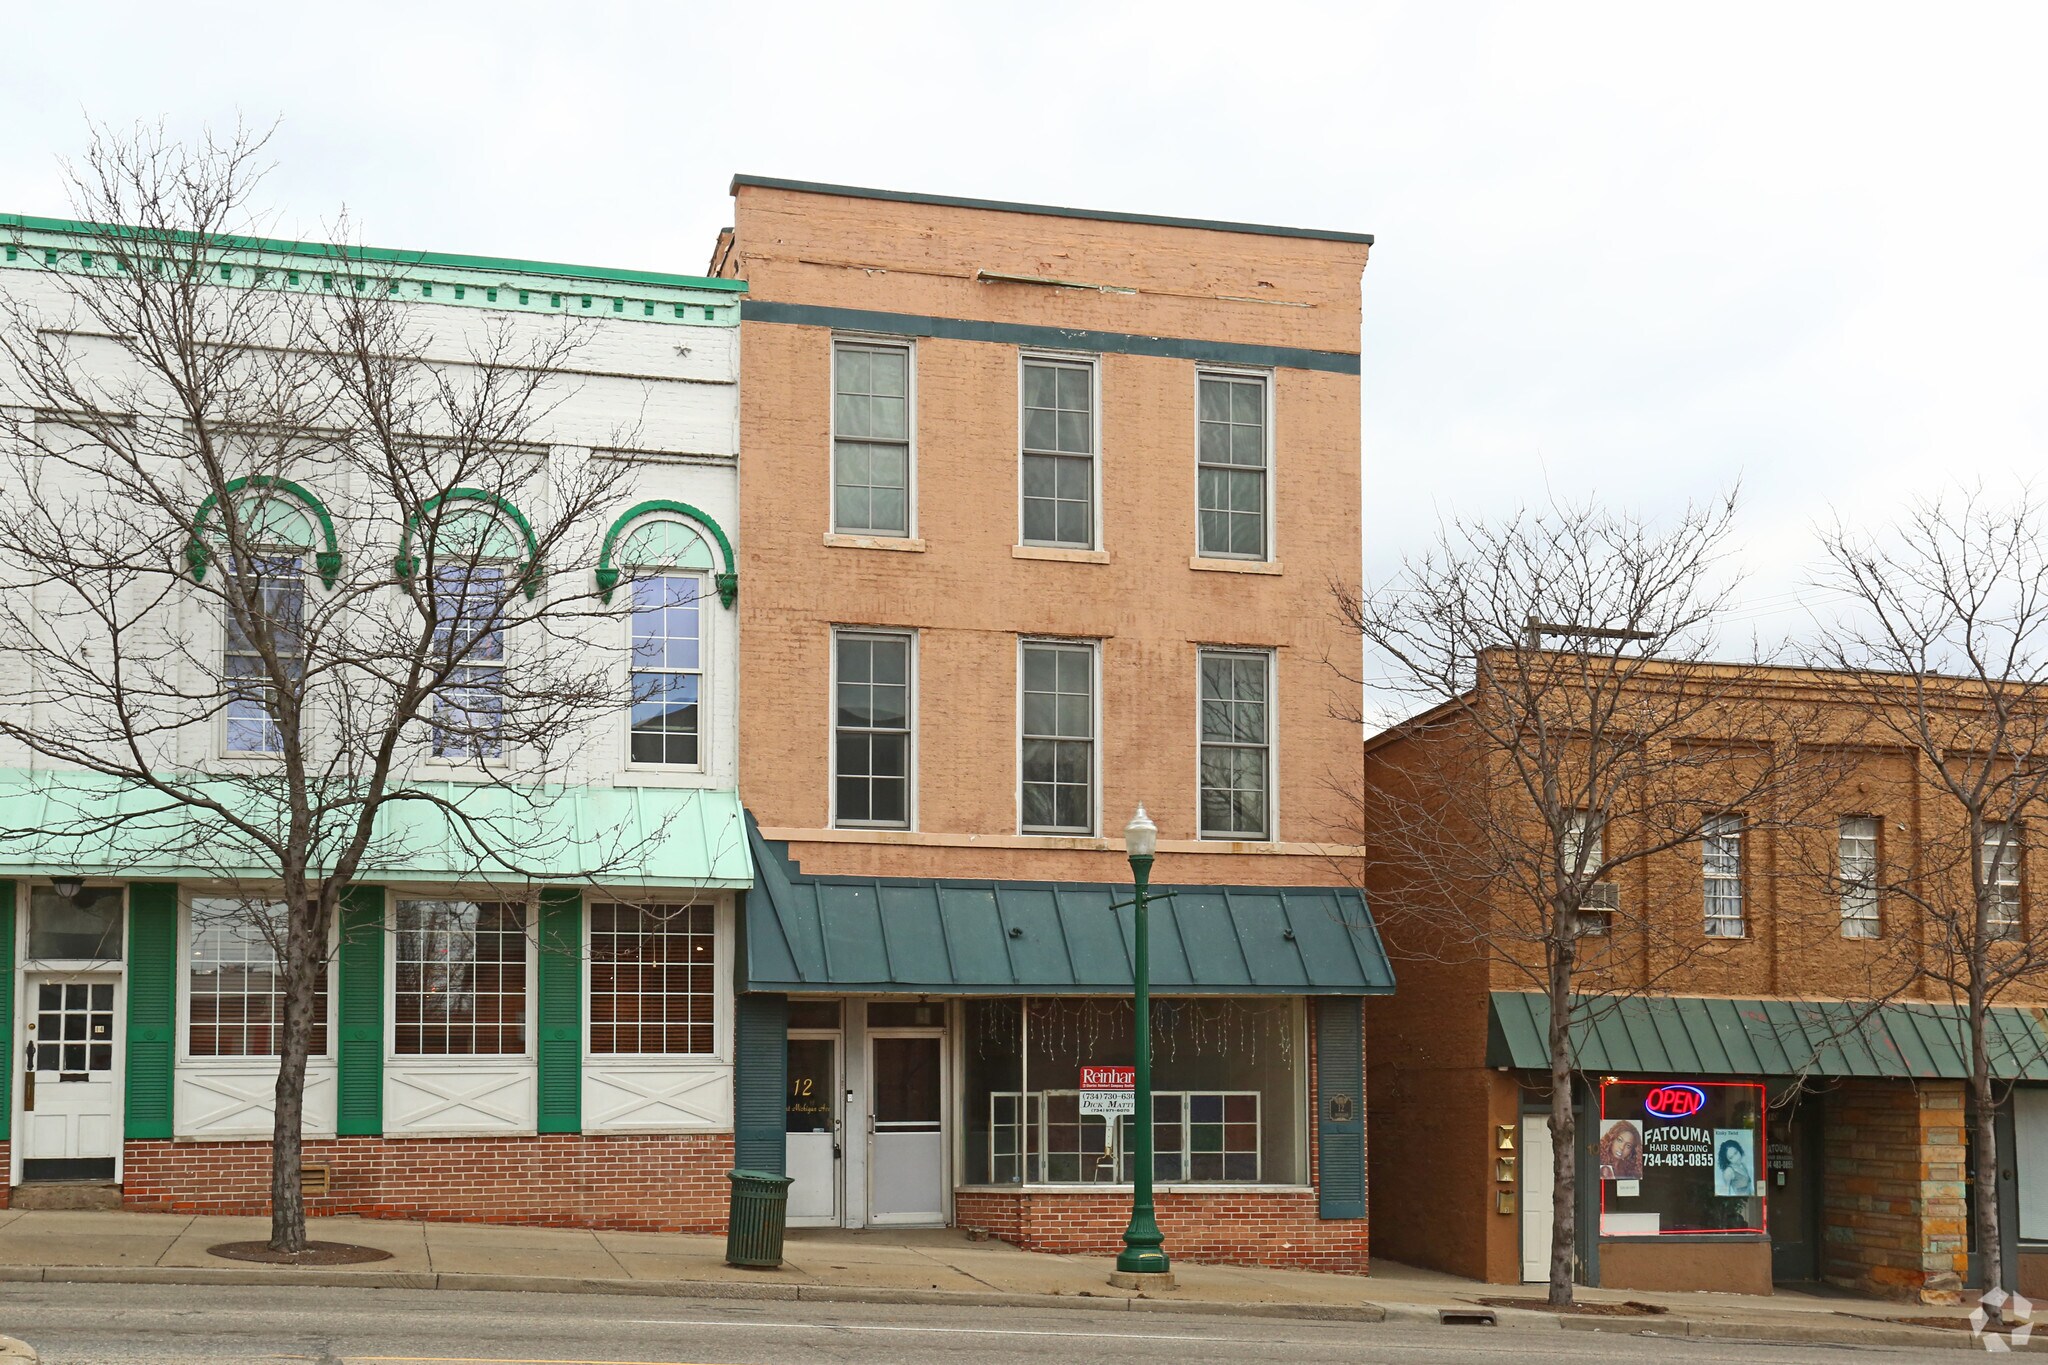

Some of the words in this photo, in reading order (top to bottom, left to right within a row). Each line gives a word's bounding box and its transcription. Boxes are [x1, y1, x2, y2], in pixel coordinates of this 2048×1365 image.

[1083, 1068, 1135, 1083] Reinhar
[794, 1078, 813, 1096] 12
[1648, 1088, 1700, 1115] OPEN
[1644, 1126, 1711, 1145] FATOUMA
[1649, 1144, 1668, 1152] HAIR
[1670, 1144, 1708, 1152] BRAIDING
[1768, 1143, 1793, 1155] ATOUMA
[1642, 1153, 1713, 1167] 734-483-0855
